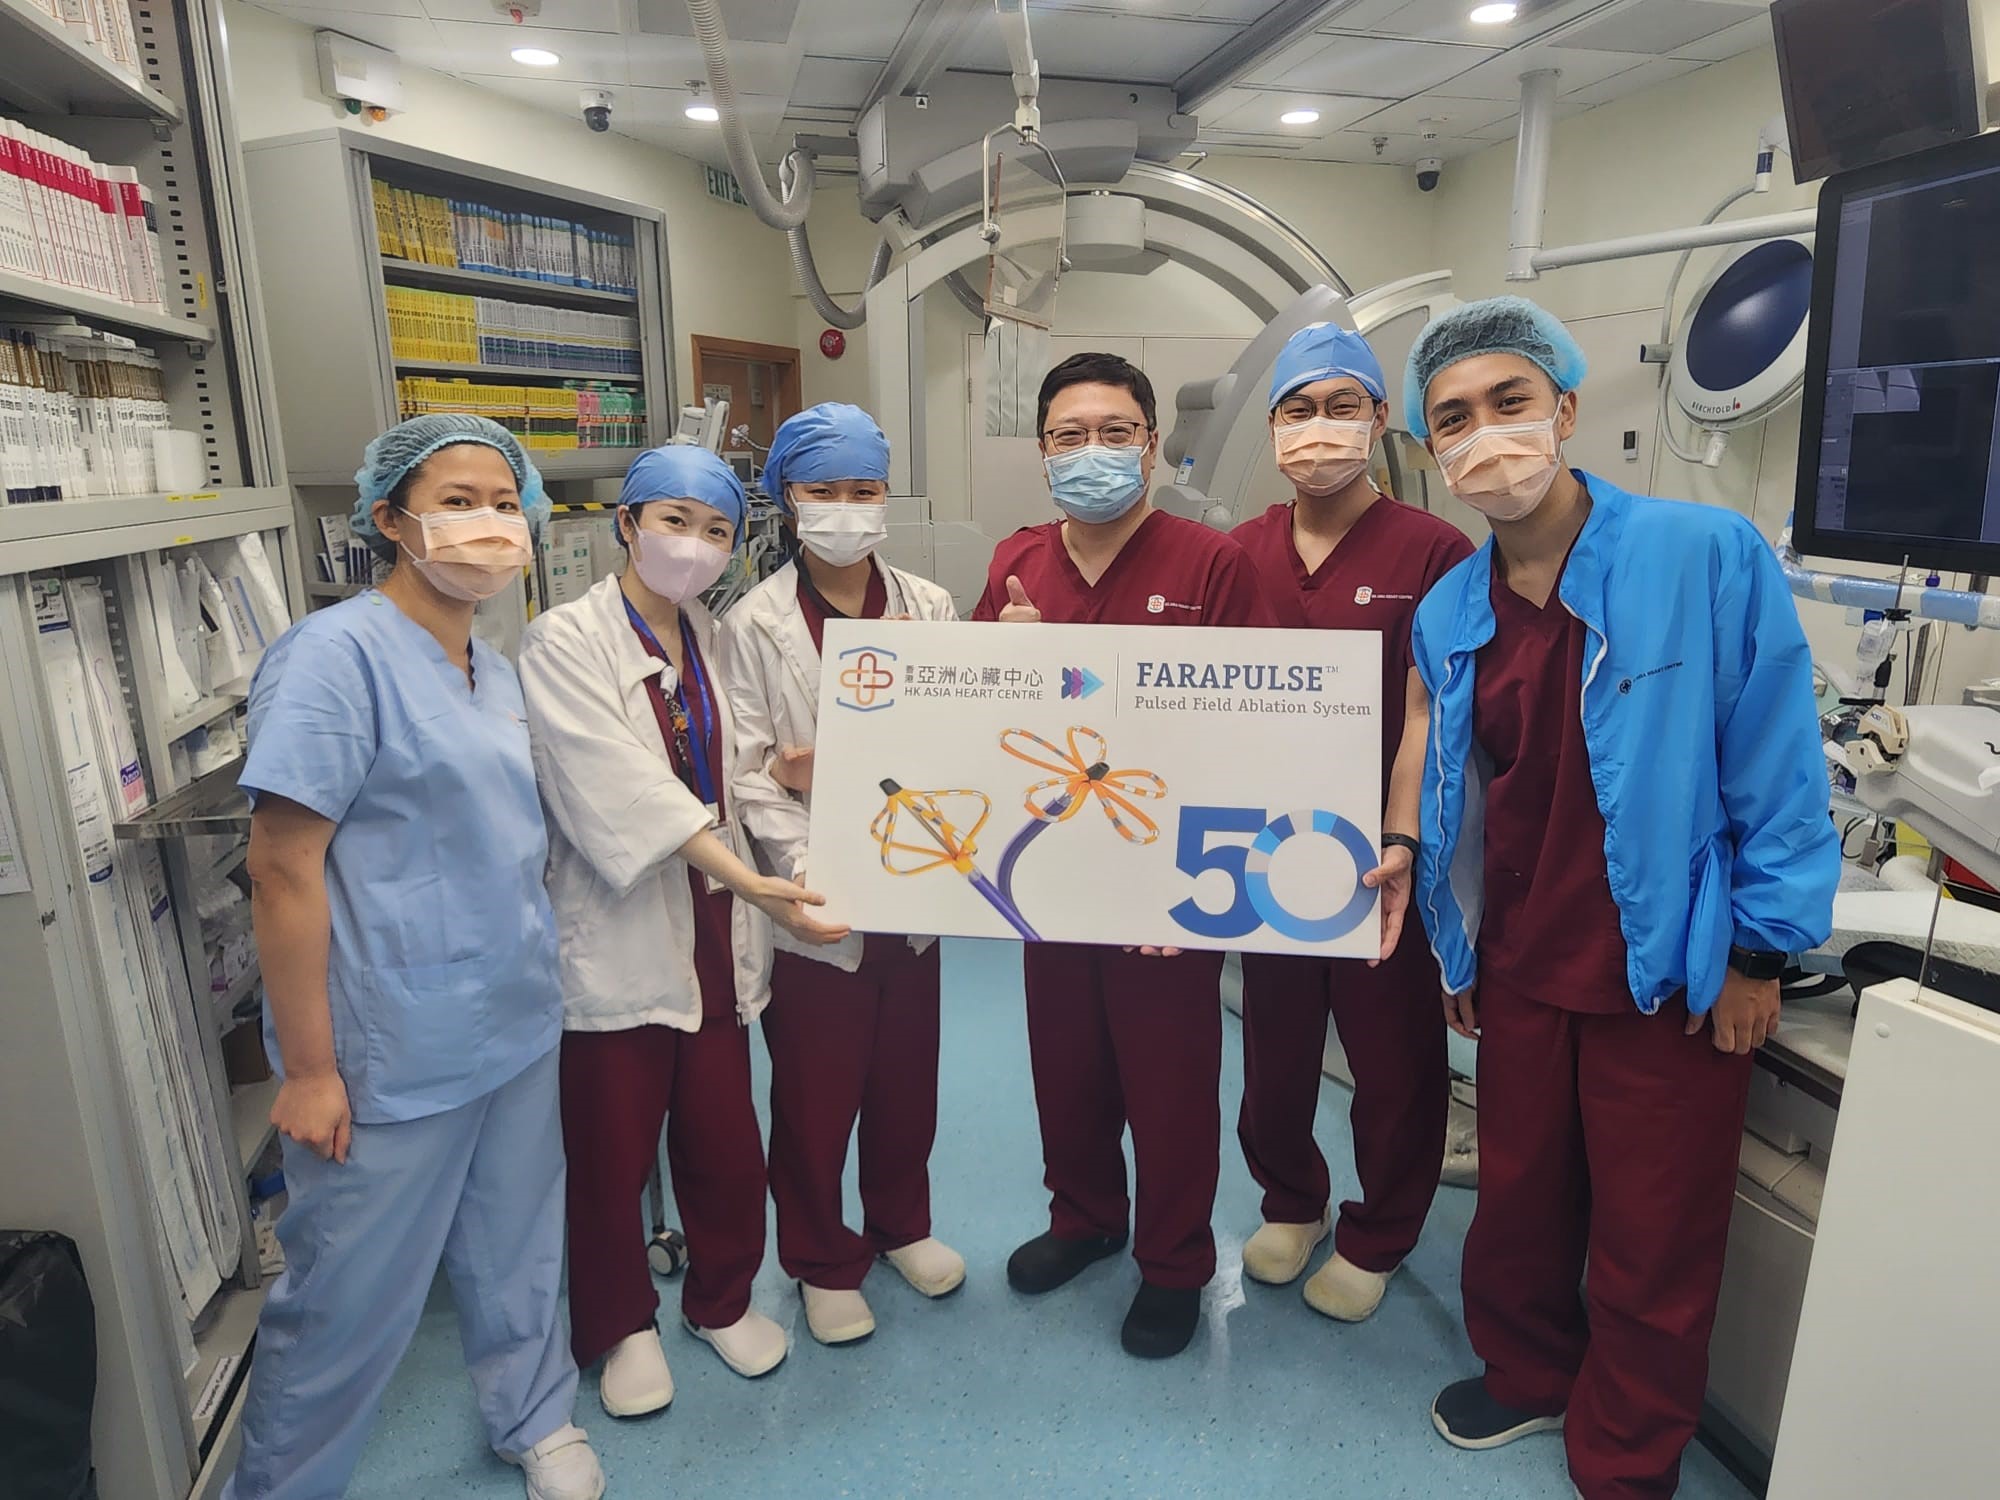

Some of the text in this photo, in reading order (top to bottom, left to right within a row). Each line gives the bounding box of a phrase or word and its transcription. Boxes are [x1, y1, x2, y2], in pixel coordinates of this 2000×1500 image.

[917, 665, 1044, 687] 亞洲心臟中心
[904, 687, 1043, 700] HK ASIA HEART CENTRE
[1134, 696, 1371, 718] Pulsed Field Ablation System
[1168, 806, 1379, 943] 50
